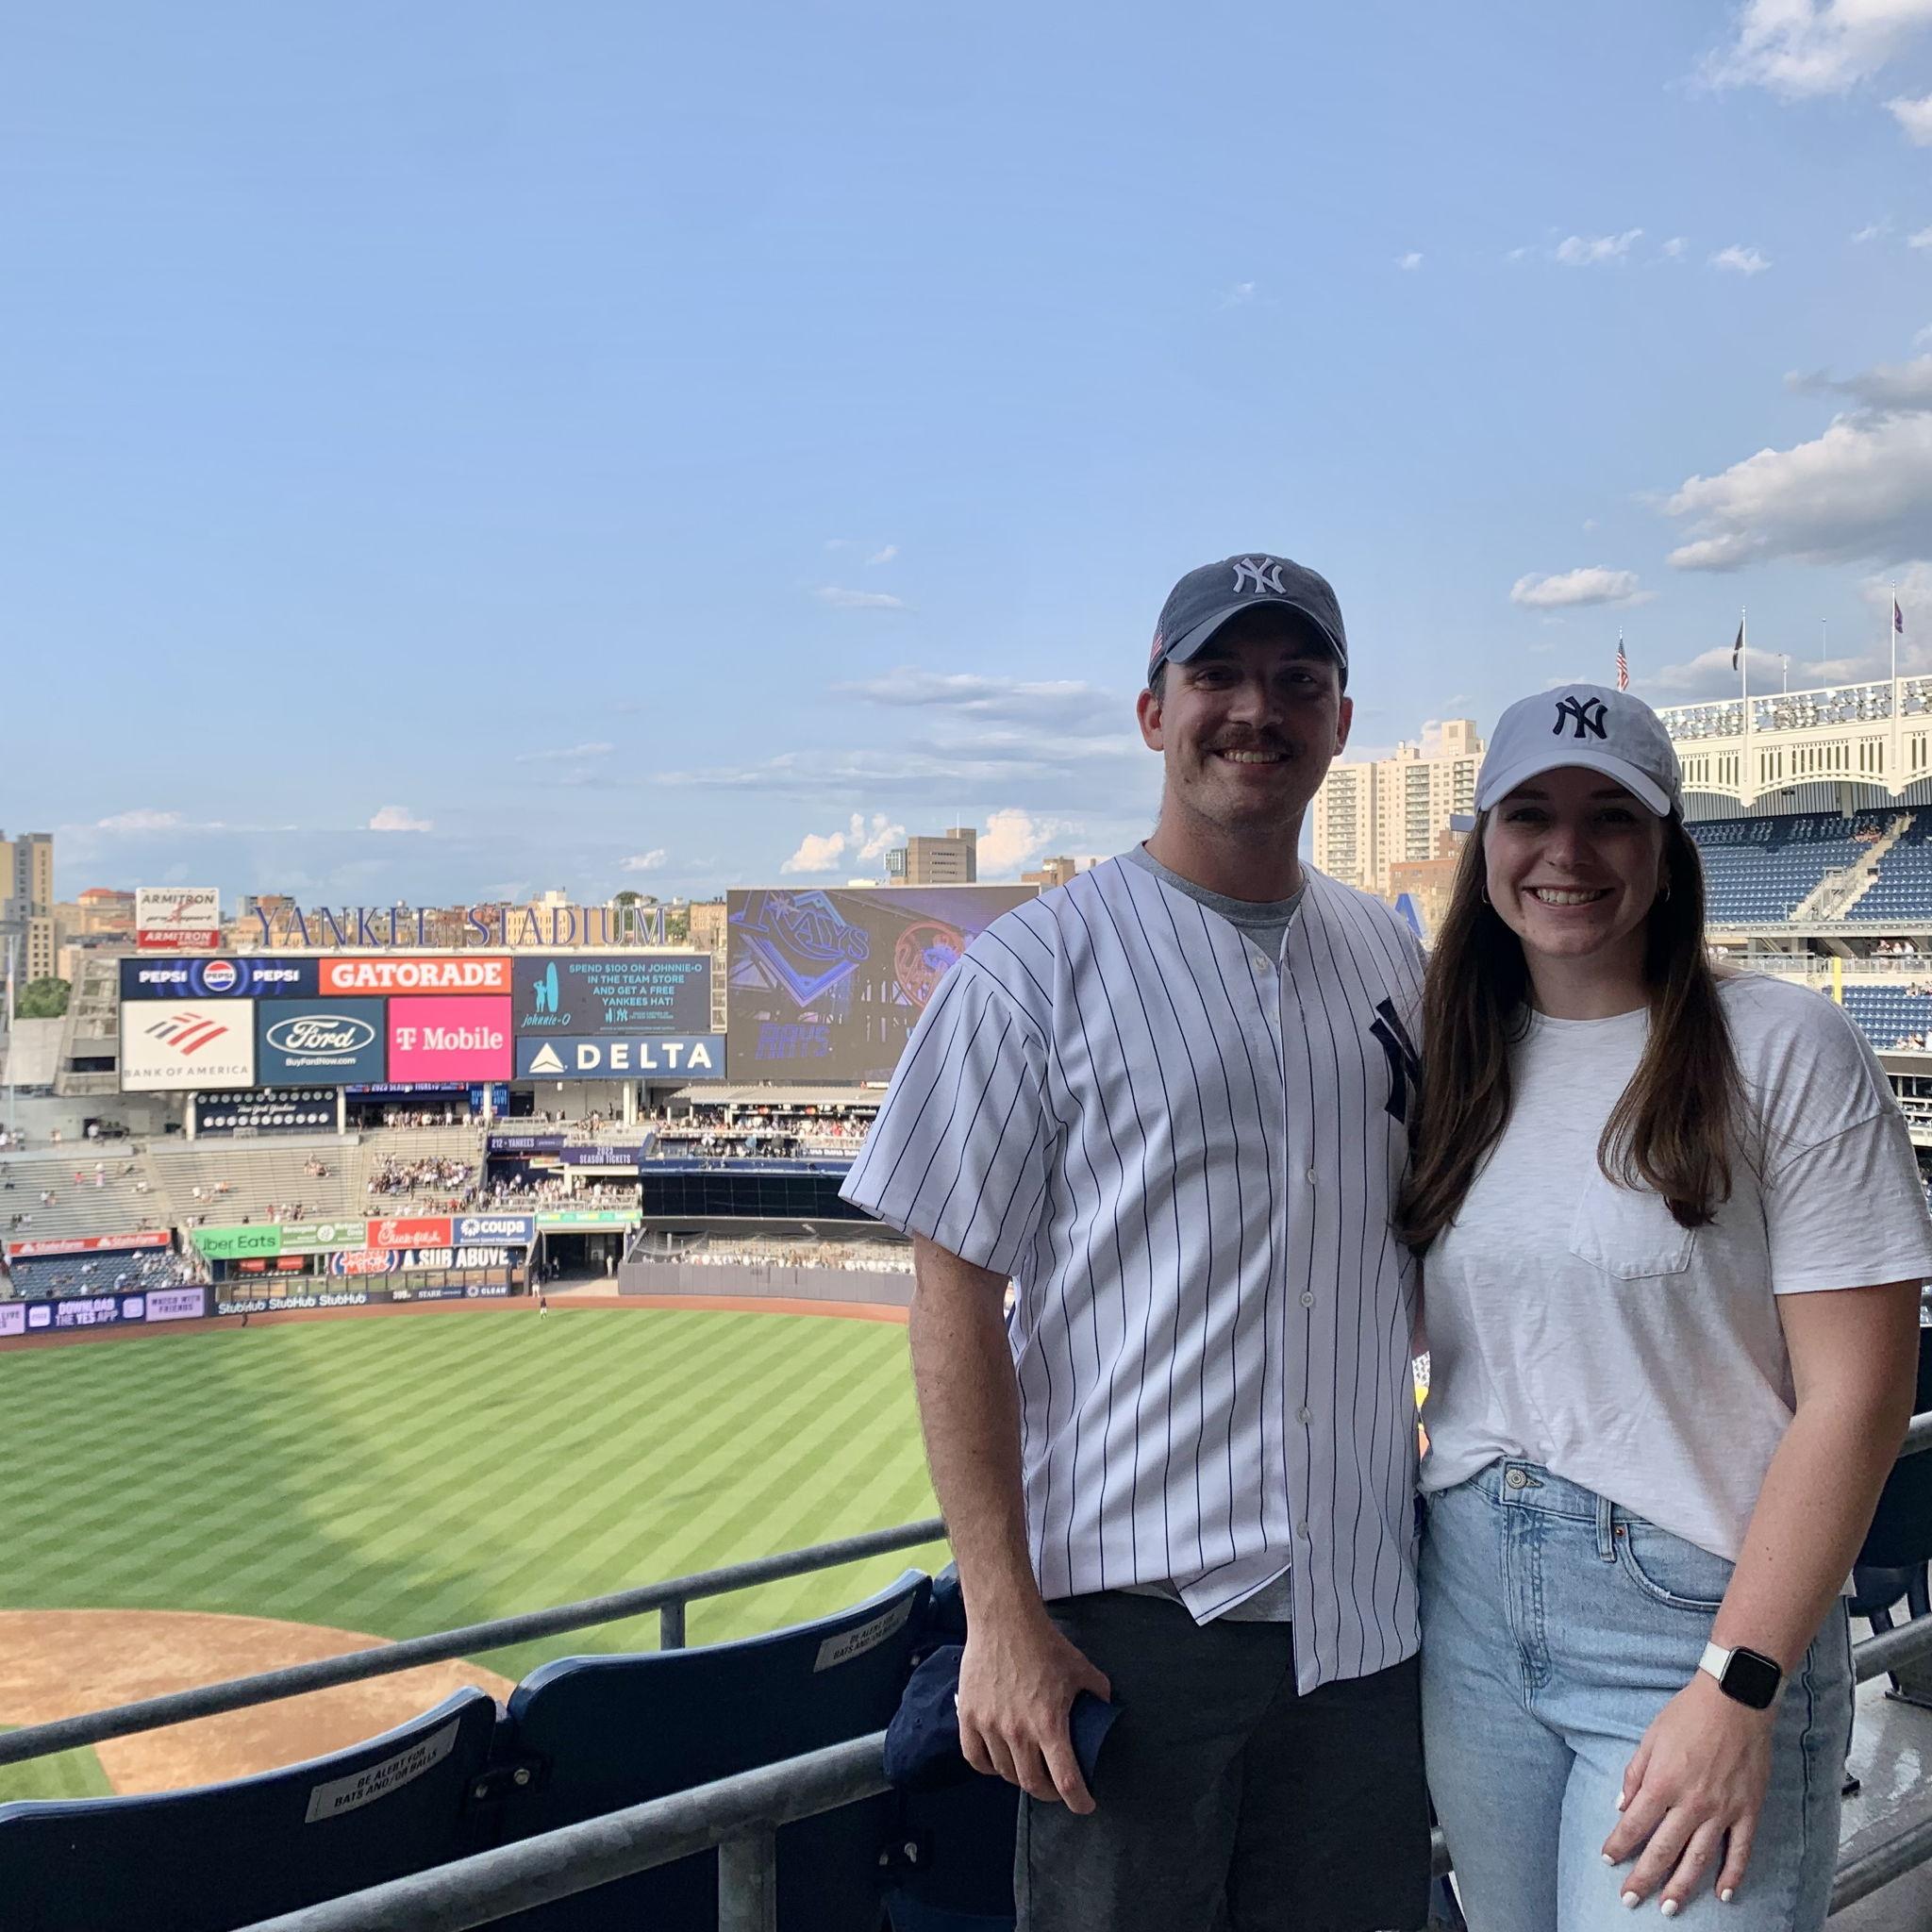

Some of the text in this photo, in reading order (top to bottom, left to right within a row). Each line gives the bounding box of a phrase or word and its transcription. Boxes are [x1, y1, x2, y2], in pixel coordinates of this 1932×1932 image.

[1233, 557, 1287, 594] NY
[1553, 695, 1608, 740] NY
[142, 894, 215, 905] ARMITRON
[466, 906, 668, 947] STADIUM
[144, 931, 212, 942] ARMITRON
[139, 970, 188, 983] PEPSI
[253, 970, 300, 982] PEPSI
[331, 962, 502, 988] GATORADE
[569, 963, 603, 974] SPEND
[605, 963, 628, 974] $100
[630, 963, 646, 973] ON
[588, 974, 685, 984] IN THE TEAM STORE
[592, 986, 675, 995] AND GET A FREE
[602, 996, 674, 1007] YANKEES HAT!
[285, 1020, 357, 1049] Ford
[423, 1026, 504, 1051] Mobile
[755, 1023, 832, 1060] RAYS
[285, 1057, 357, 1067] BuyFordNow.com
[576, 1042, 712, 1070] DELTA
[123, 1065, 249, 1078] BANK OF AMERICA
[491, 1138, 503, 1149] 212
[508, 1138, 535, 1149] YANKEES
[596, 1146, 613, 1156] 2023
[579, 1155, 631, 1164] SEASON TICKETS
[480, 1220, 525, 1238] coupa
[238, 1236, 275, 1249] Eats
[402, 1249, 416, 1269] A
[419, 1248, 453, 1269] SUB
[456, 1247, 509, 1268] ABOVE
[58, 1298, 115, 1315] DOWNLOAD
[218, 1291, 366, 1315] StubHub StubHub StubHub
[56, 1315, 75, 1326] THE
[76, 1312, 95, 1325] YES
[97, 1310, 119, 1323] APP
[357, 1746, 426, 1789] BE ALERT FOR
[334, 1749, 438, 1807] BATS AND/OR BALLS
